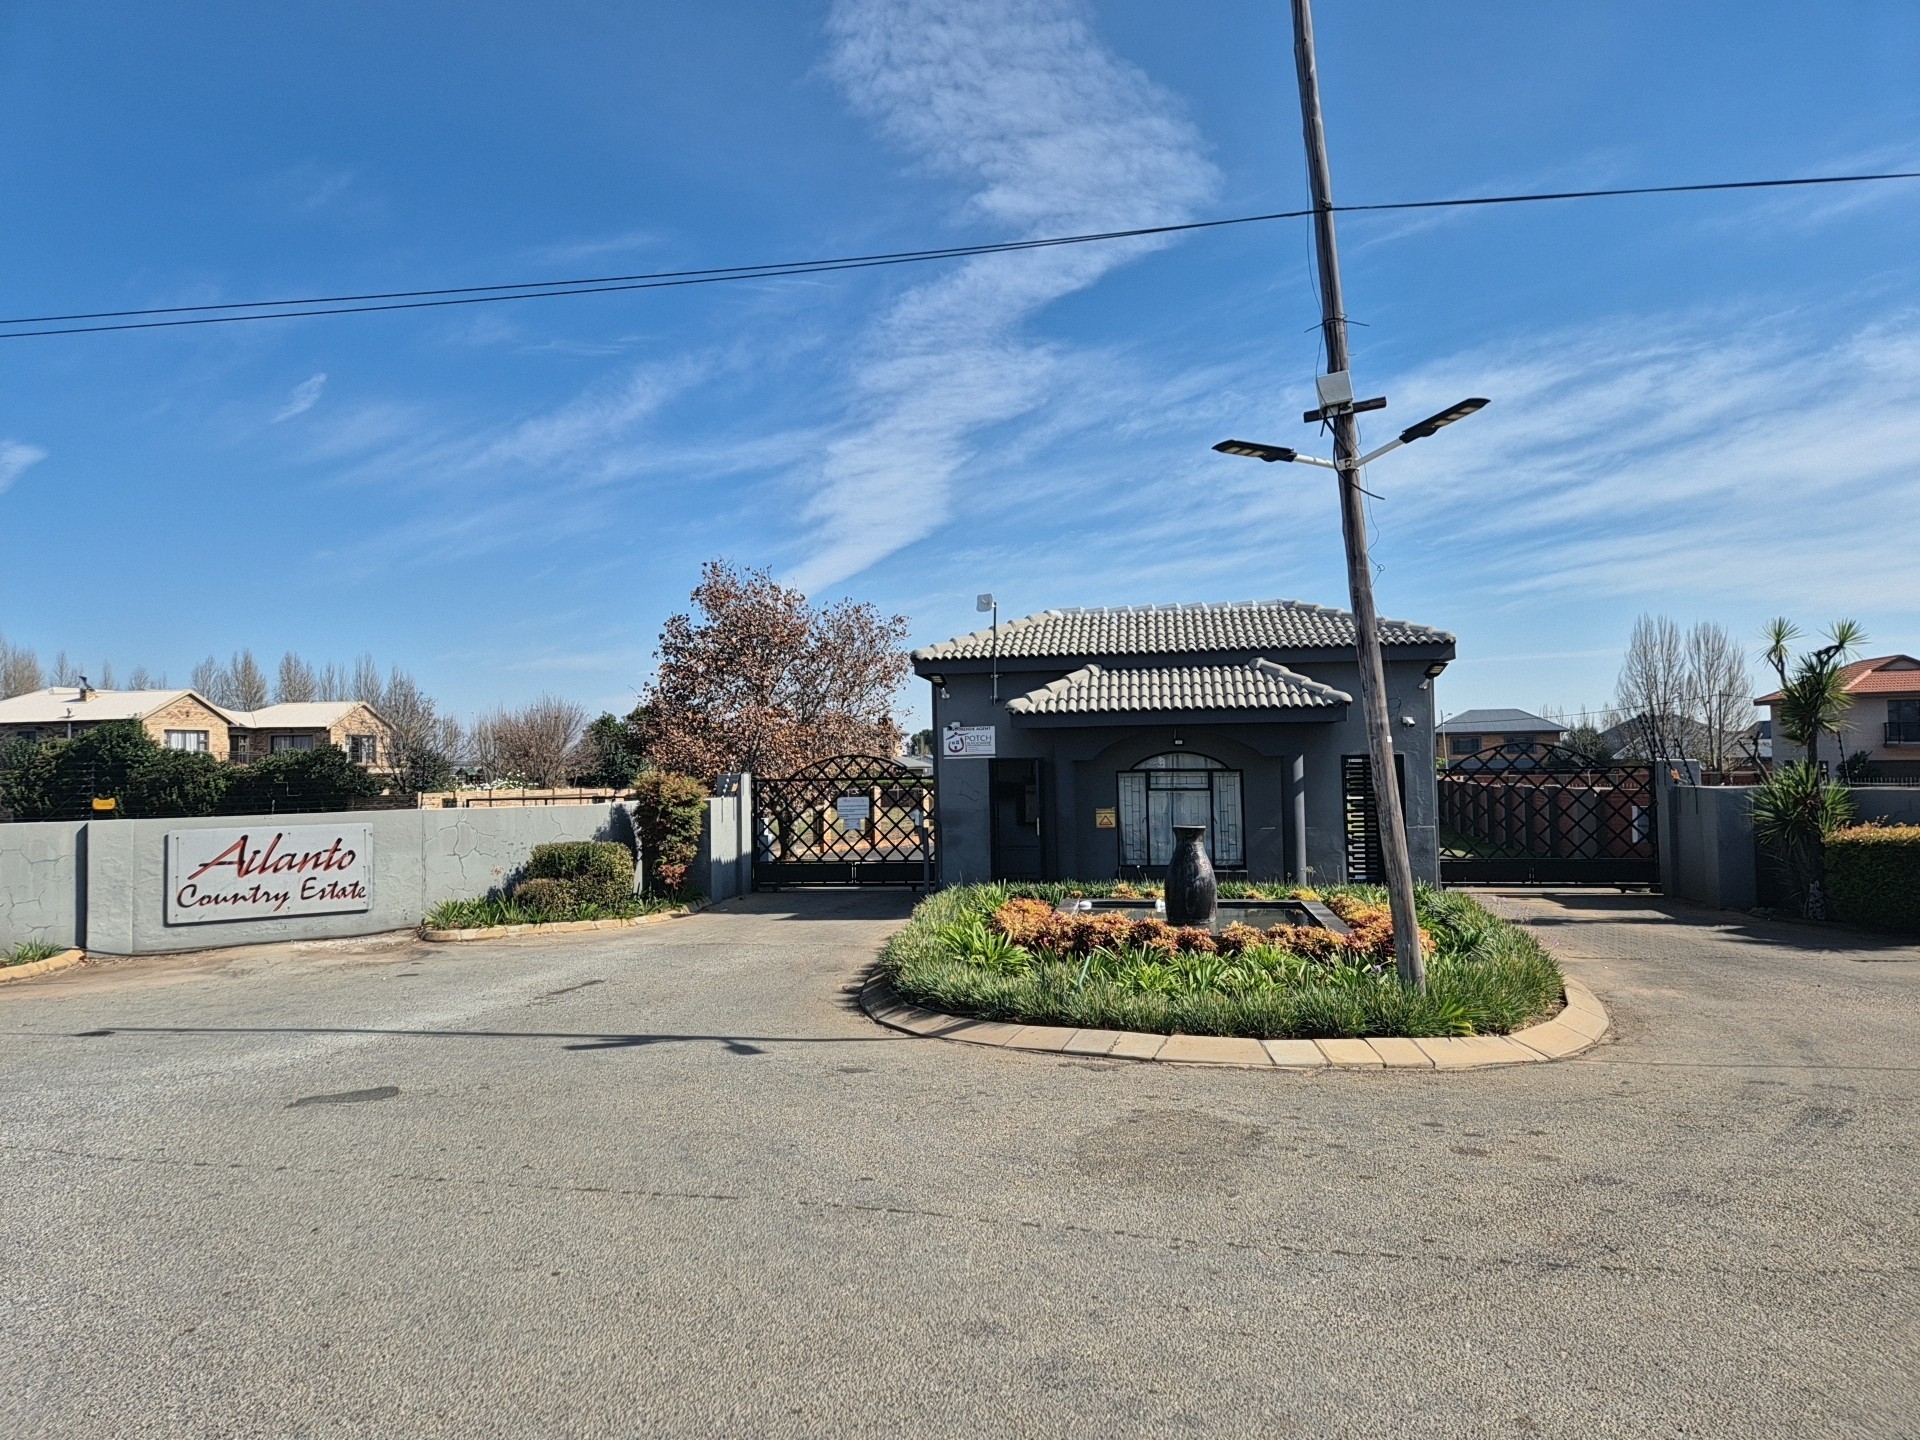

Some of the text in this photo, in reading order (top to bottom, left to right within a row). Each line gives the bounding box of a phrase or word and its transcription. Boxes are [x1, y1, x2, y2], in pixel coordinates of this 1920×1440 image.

[187, 833, 356, 880] Ailanto
[177, 877, 366, 911] Country Estate
